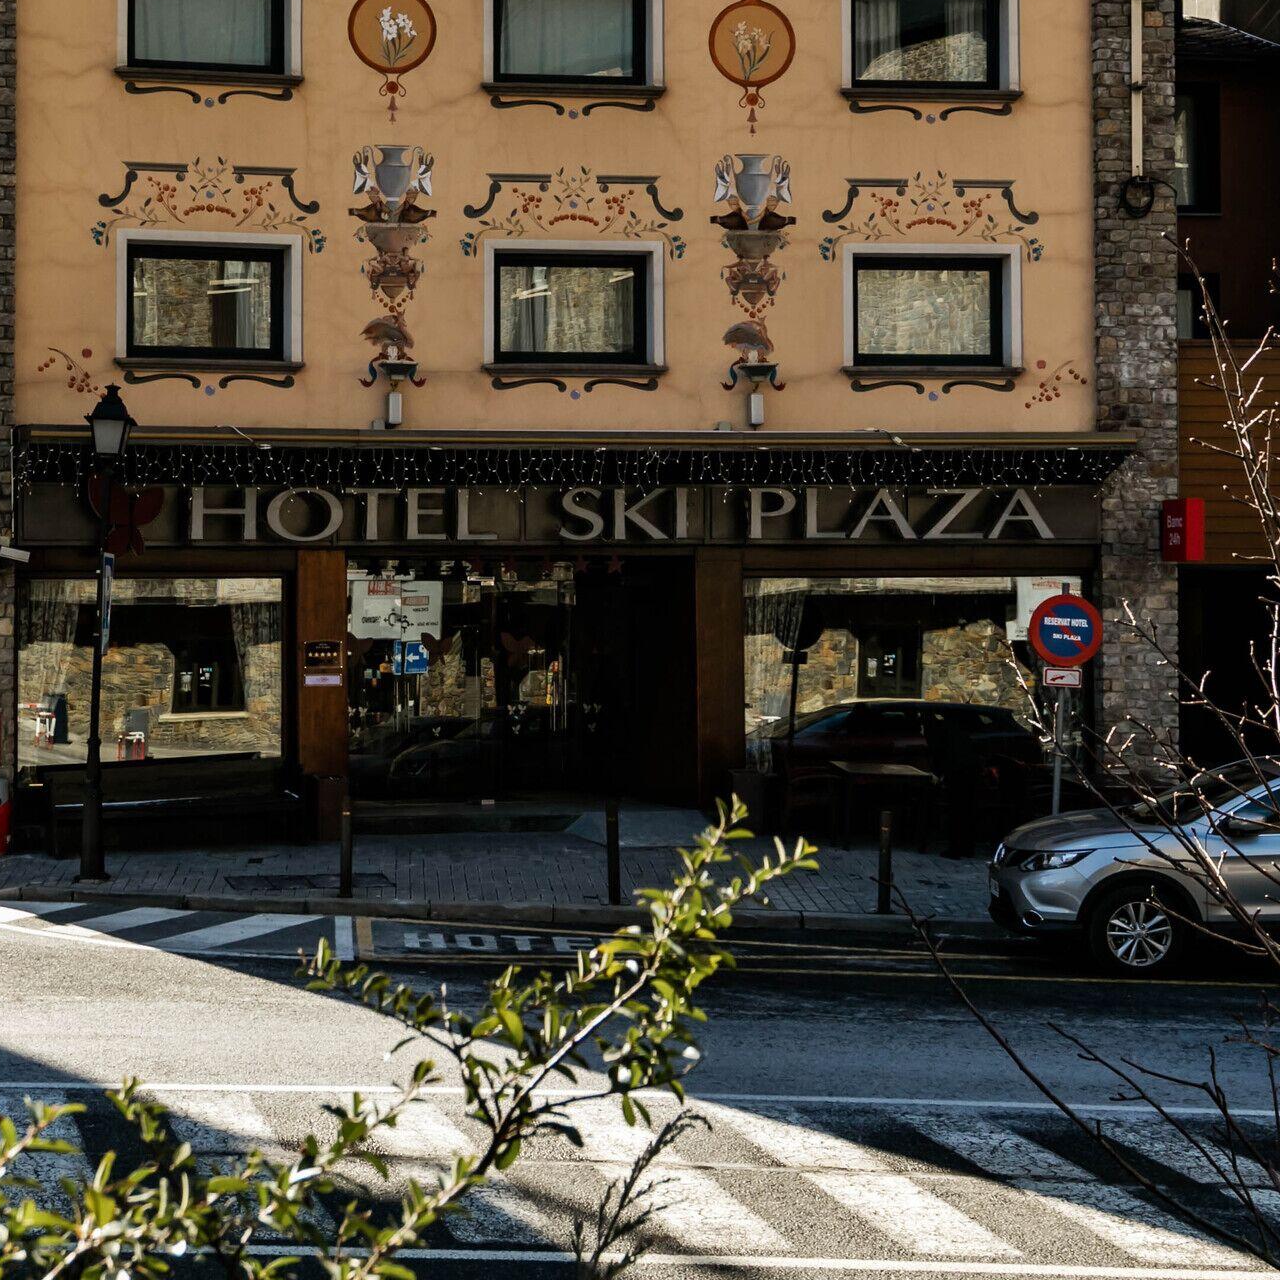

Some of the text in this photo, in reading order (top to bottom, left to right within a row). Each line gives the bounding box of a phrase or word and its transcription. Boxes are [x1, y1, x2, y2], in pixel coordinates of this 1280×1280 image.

[190, 487, 1056, 542] HOTEL SKI PLAZA
[1043, 616, 1089, 628] RESERVAT HOTEL
